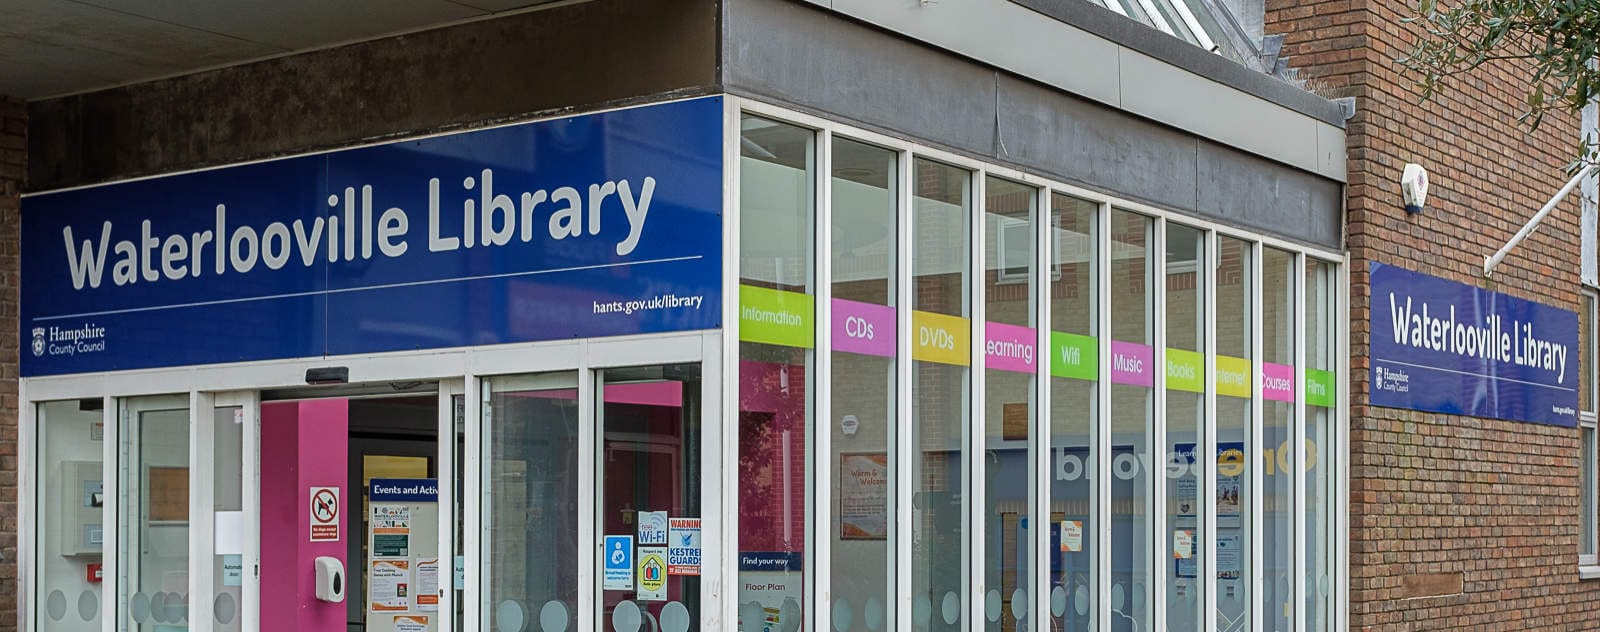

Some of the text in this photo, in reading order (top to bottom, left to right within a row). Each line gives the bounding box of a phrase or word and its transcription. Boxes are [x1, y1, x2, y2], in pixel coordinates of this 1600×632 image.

[63, 168, 656, 290] Waterlooville Library
[593, 295, 703, 315] hants.gov.uk/library
[742, 304, 802, 327] Information
[49, 323, 105, 344] Hampshire
[845, 316, 874, 341] CDs
[1389, 292, 1567, 384] Waterlooville Library
[49, 340, 105, 357] County Council
[920, 327, 954, 351] DVDs
[985, 339, 1033, 364] earning
[1061, 345, 1081, 366] Wifi
[1114, 354, 1143, 374] Music
[1167, 360, 1195, 379] Books
[1216, 369, 1248, 386] nternet
[1307, 379, 1325, 396] Films
[850, 470, 871, 478] Warm
[861, 477, 886, 486] Welcom
[374, 485, 438, 495] Events and Activ
[640, 530, 665, 543] Wi-Fi
[742, 557, 758, 565] Find
